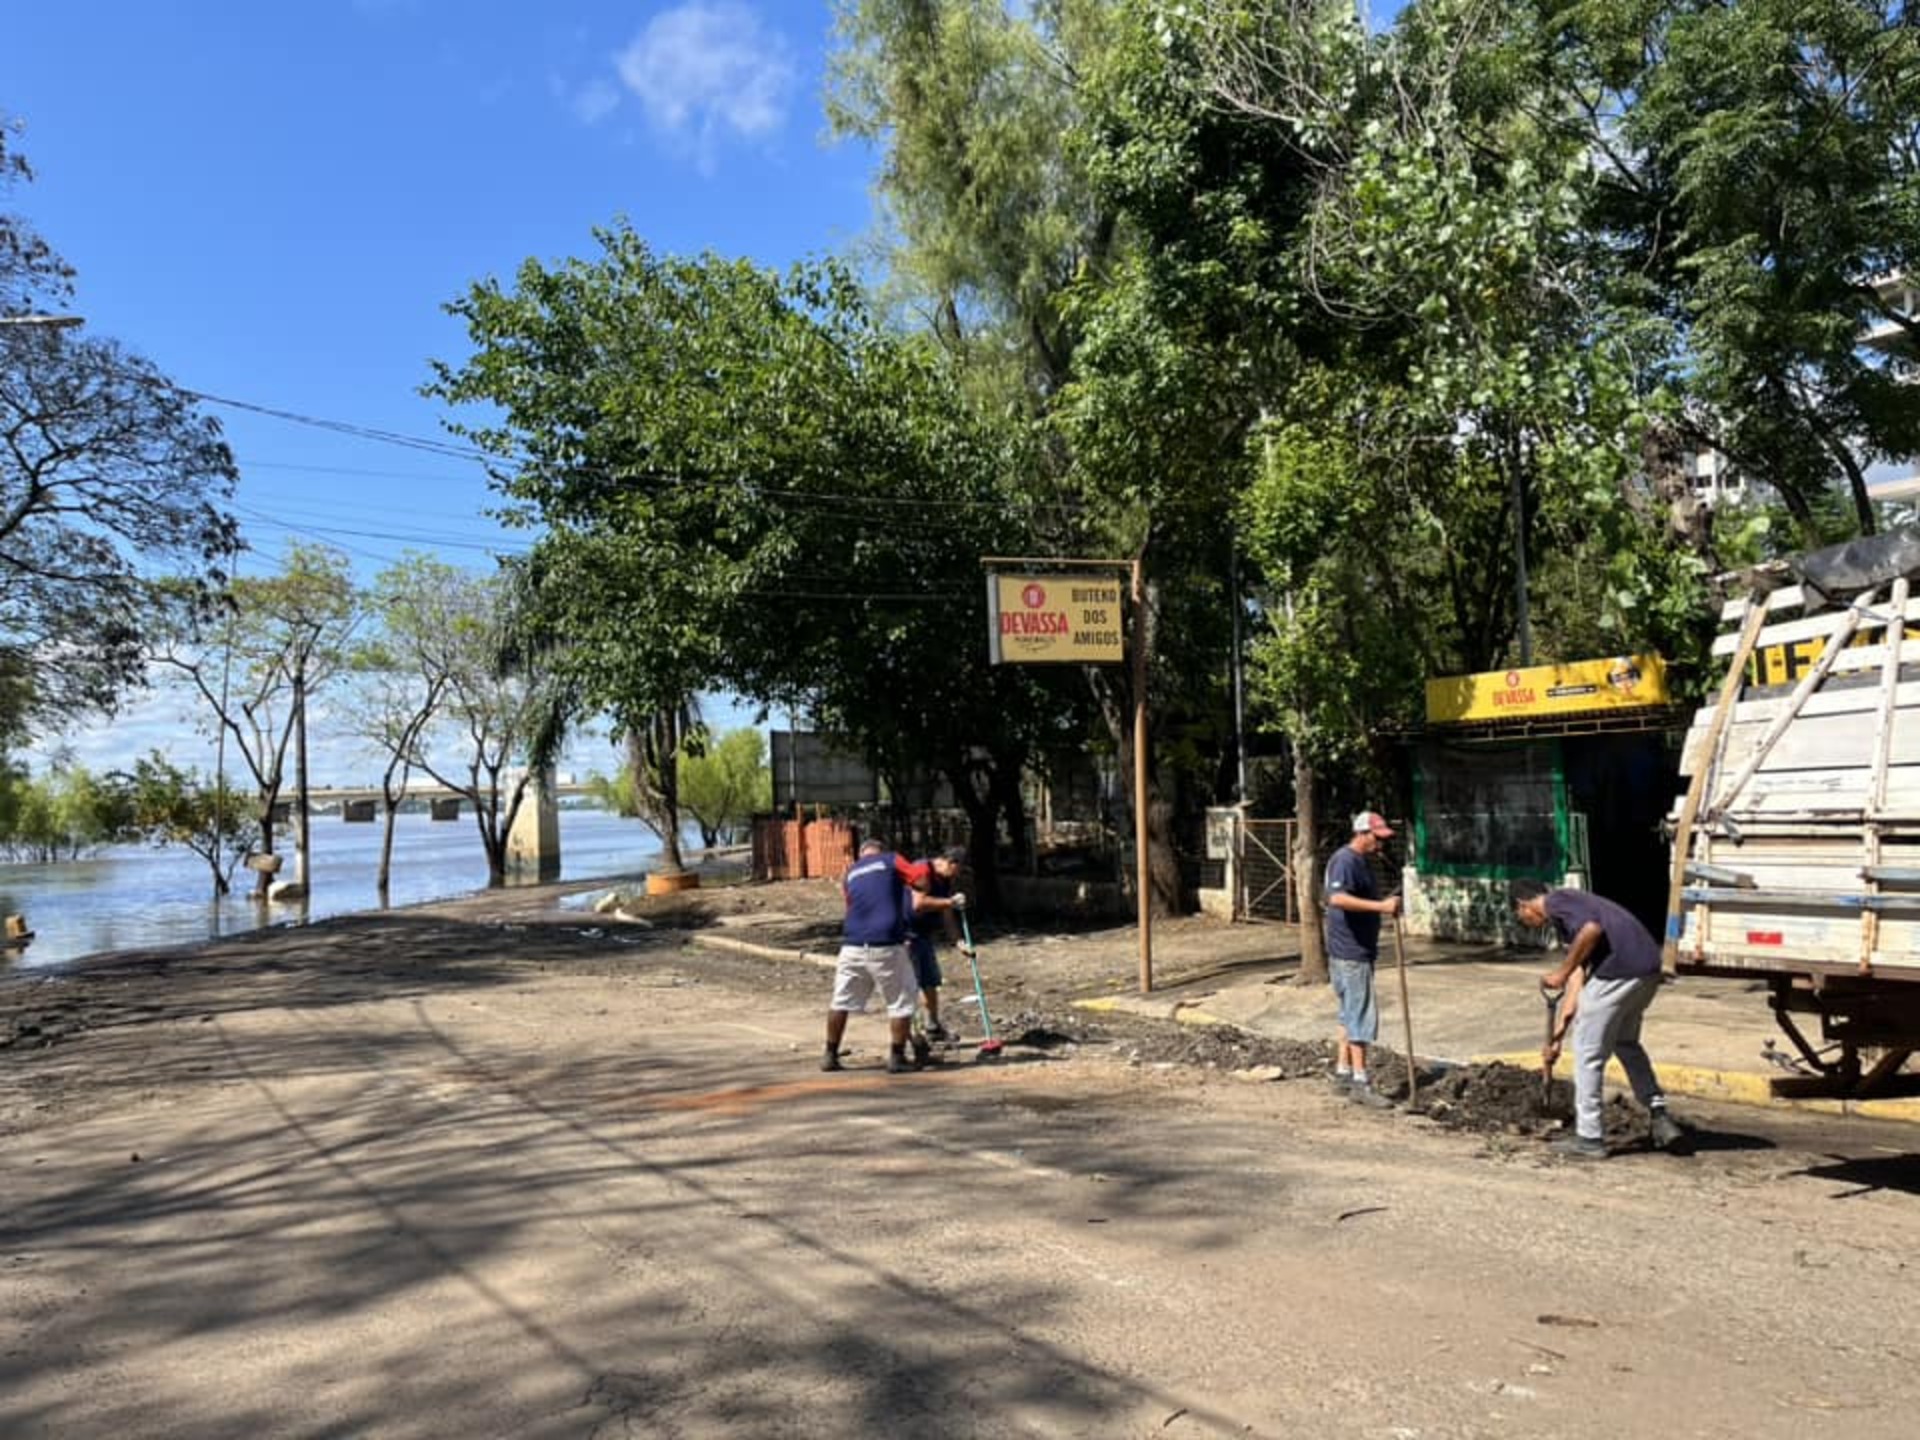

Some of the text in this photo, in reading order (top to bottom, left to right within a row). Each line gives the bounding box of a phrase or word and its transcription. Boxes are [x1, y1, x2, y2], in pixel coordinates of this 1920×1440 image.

[1001, 612, 1069, 634] DEVASSA
[1083, 610, 1107, 624] DOS
[1073, 631, 1119, 645] AMIGOS
